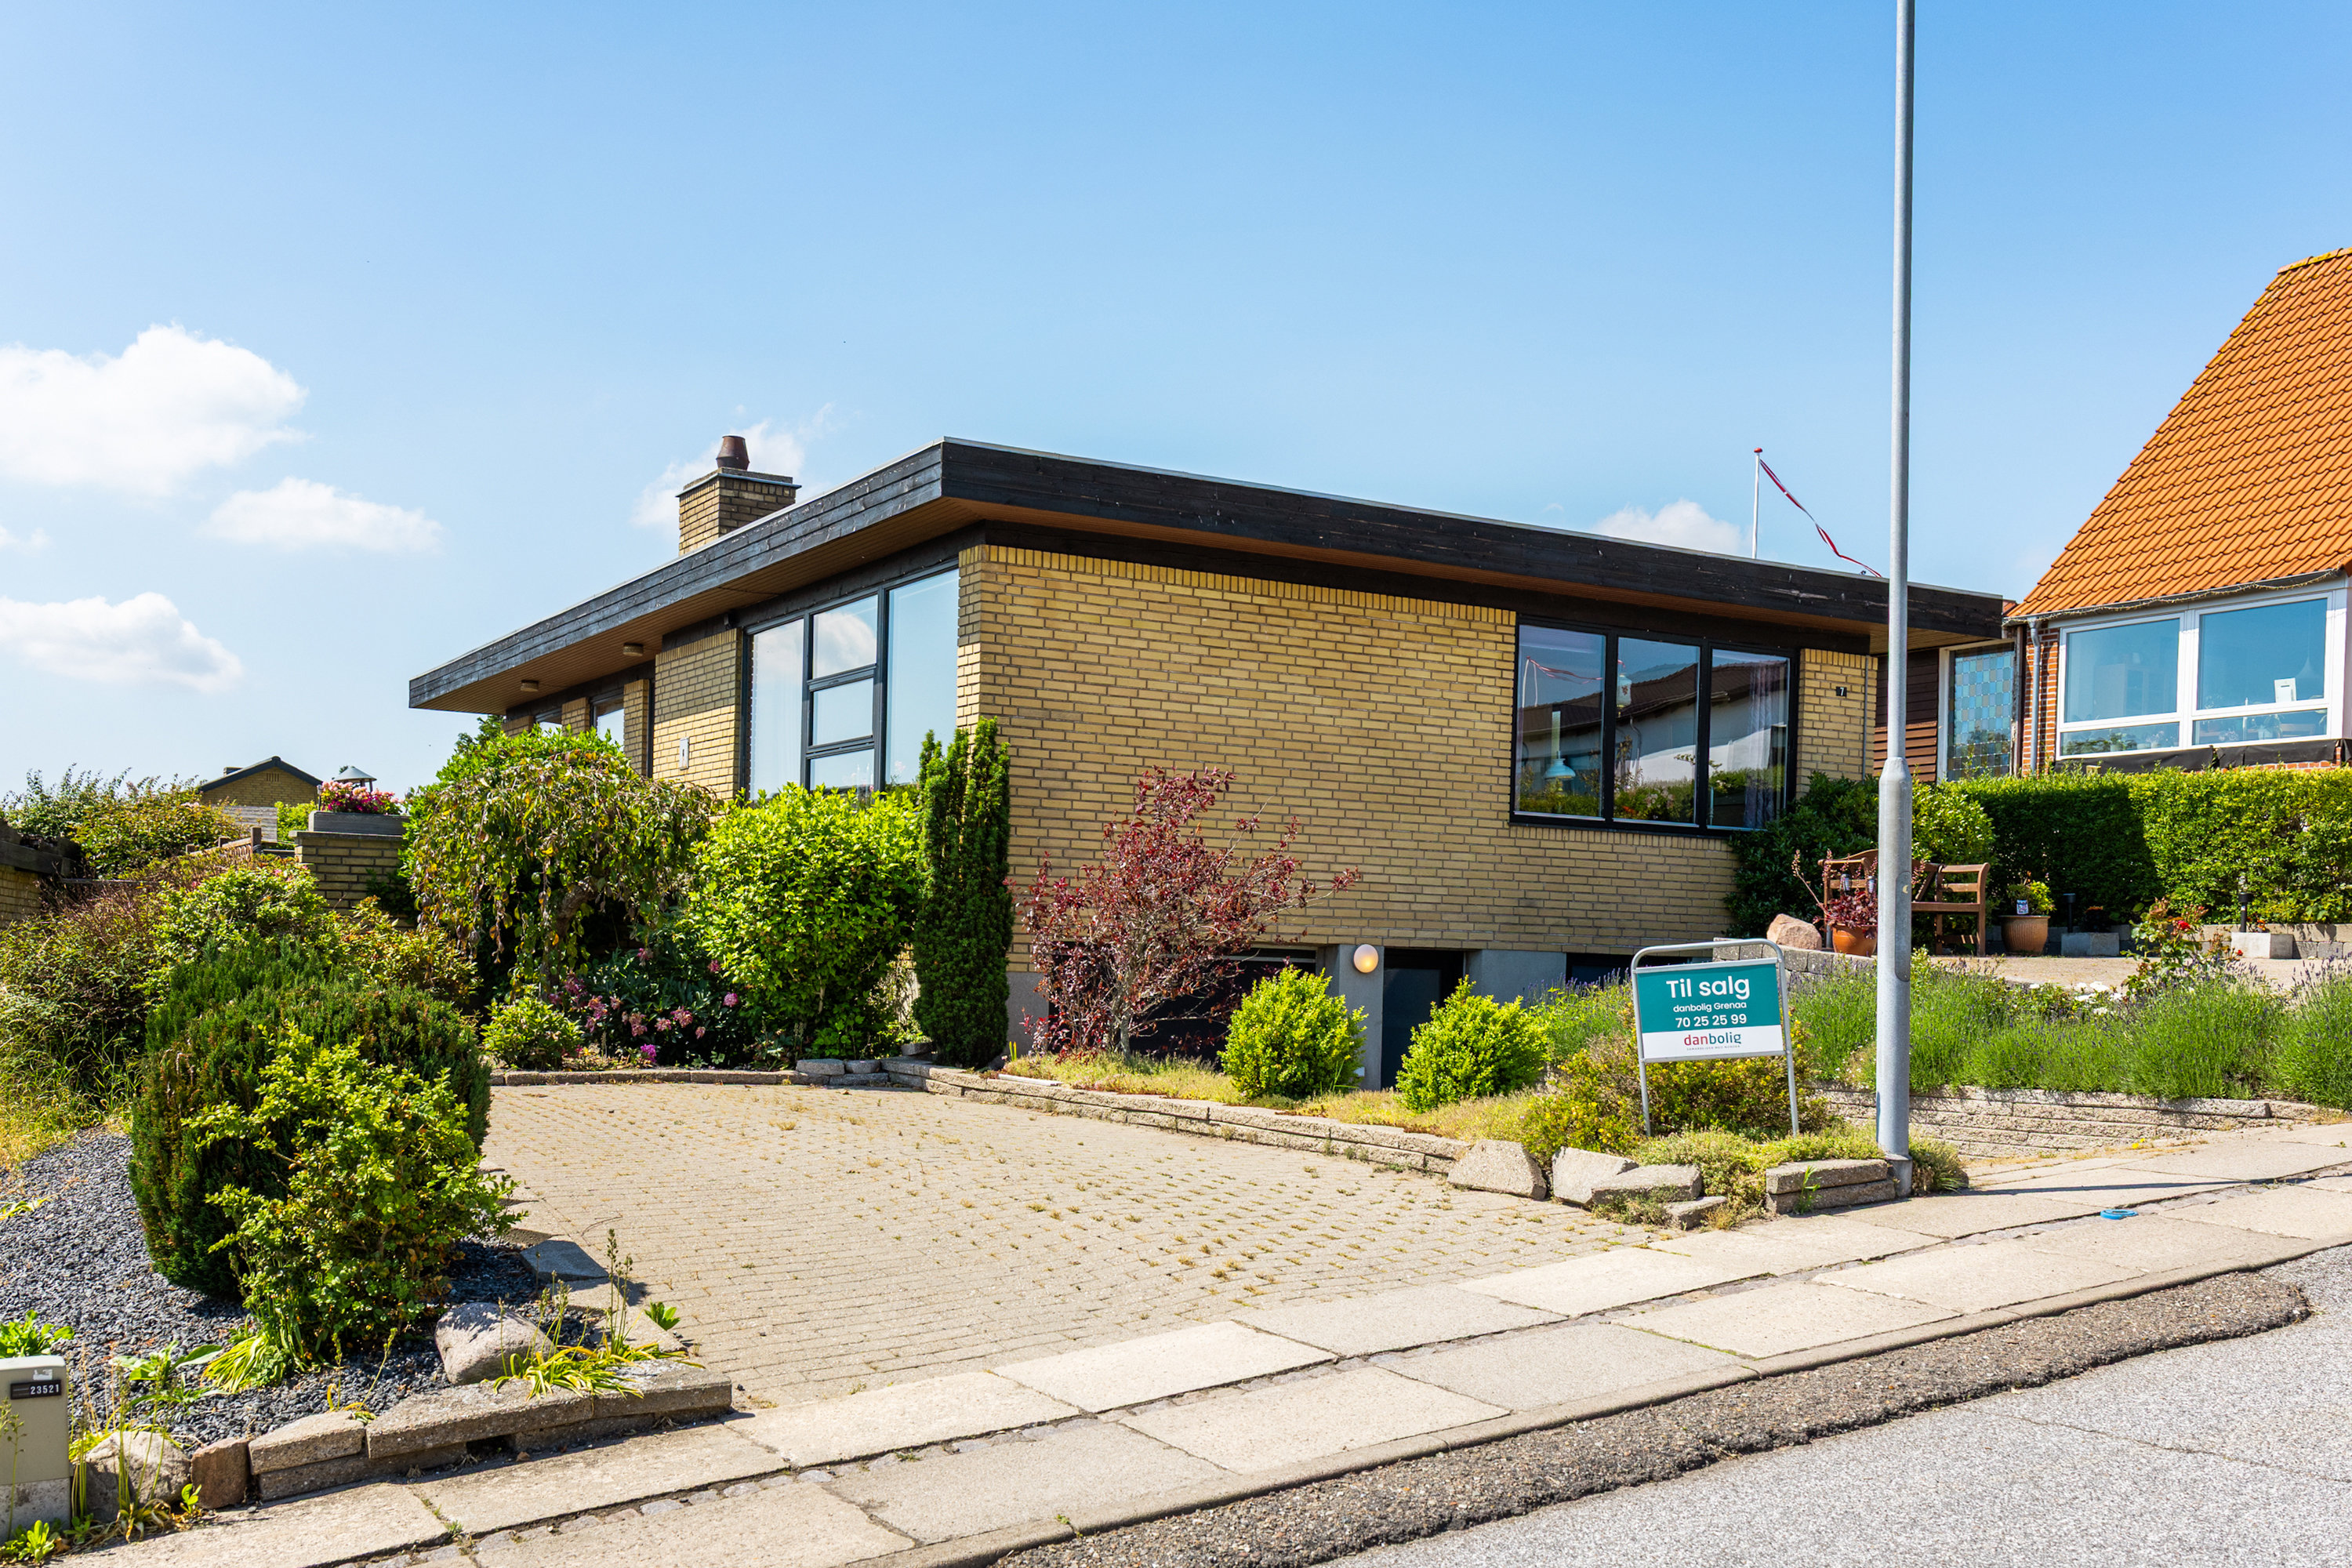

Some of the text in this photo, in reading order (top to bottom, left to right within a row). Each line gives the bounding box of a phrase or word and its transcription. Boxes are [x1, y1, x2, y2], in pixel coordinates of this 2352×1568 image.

[1839, 687, 1845, 696] 7
[1665, 975, 1750, 1000] Til salg
[1672, 1002, 1748, 1013] danbolig Grenaa
[1675, 1013, 1748, 1028] 70 25 25 99
[1683, 1032, 1742, 1046] danbolig
[30, 1384, 60, 1395] 23521
